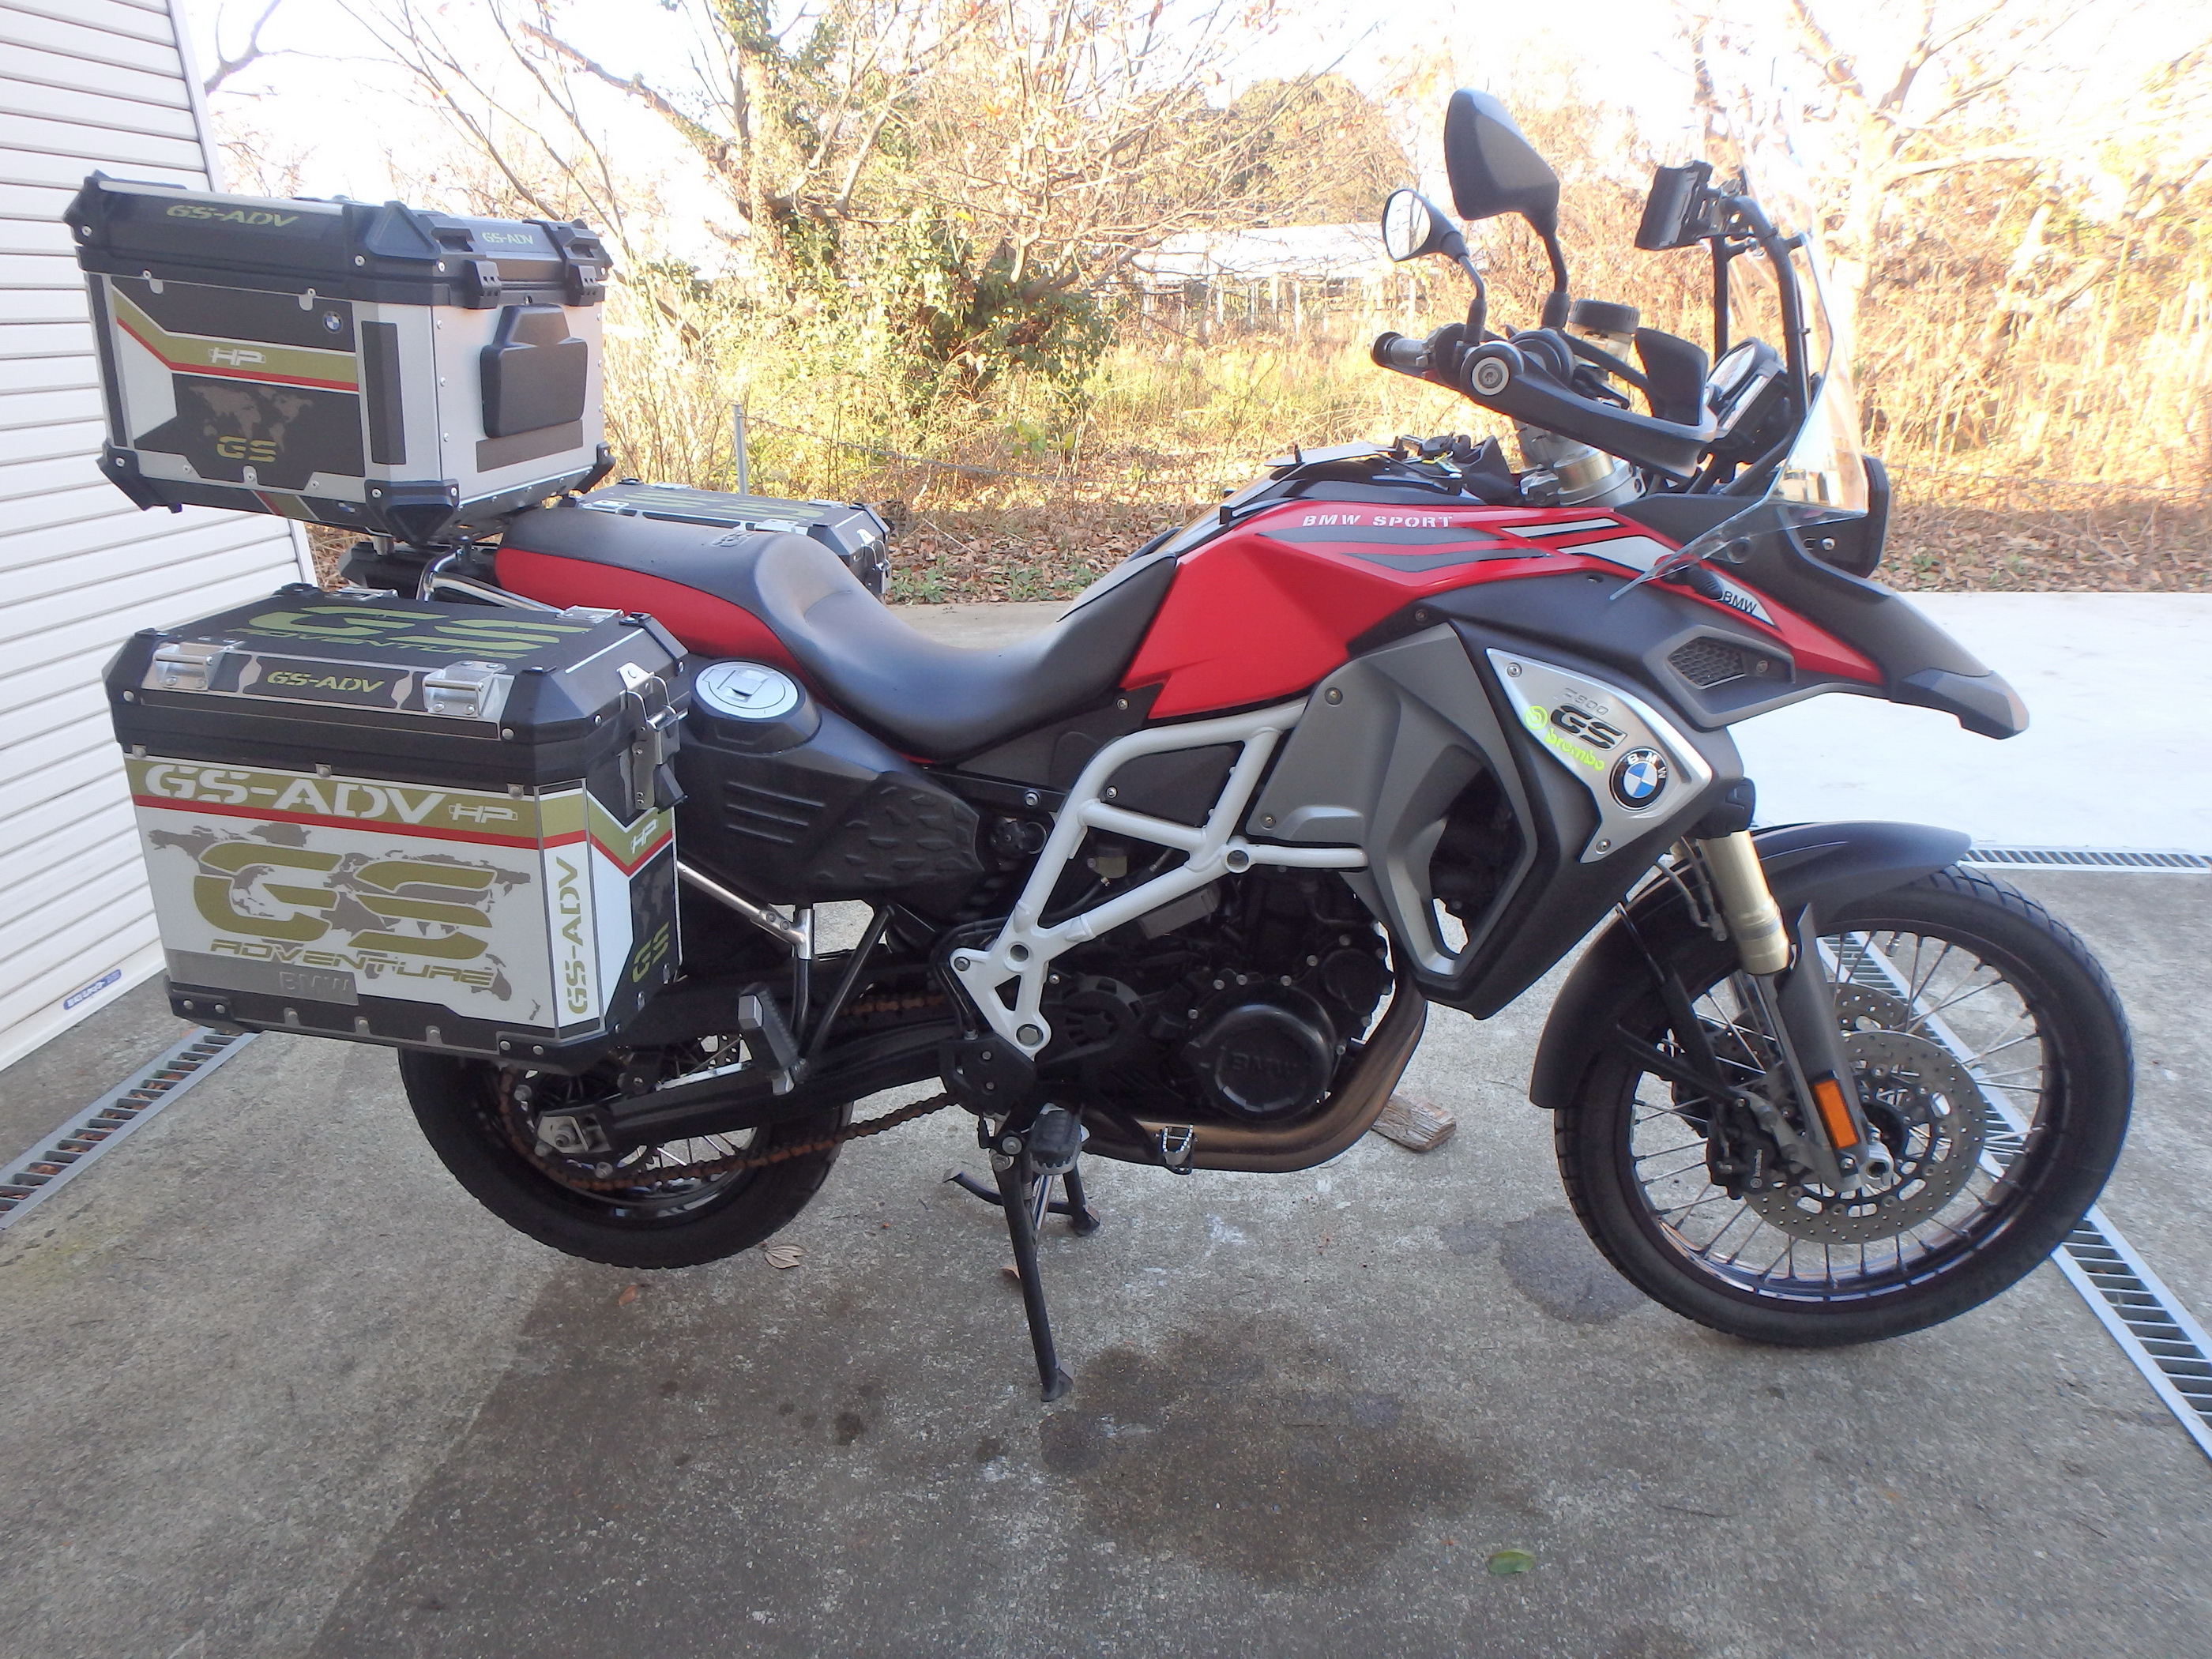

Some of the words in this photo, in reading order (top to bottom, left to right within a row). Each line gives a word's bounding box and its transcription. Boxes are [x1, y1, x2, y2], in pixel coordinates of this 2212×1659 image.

[166, 204, 299, 228] GS-ADV
[481, 231, 534, 245] GS-ADV
[208, 347, 267, 367] HP
[216, 434, 276, 462] GS
[1302, 514, 1361, 527] BMW
[1372, 514, 1454, 529] SPORT
[1721, 589, 1758, 614] BMW
[248, 605, 592, 651] GS
[266, 670, 384, 694] GS-ADV
[1550, 703, 1627, 750] GS
[1544, 727, 1605, 772] brembo
[1626, 750, 1668, 780] BMW
[144, 763, 449, 824] GS-ADV
[448, 802, 518, 825] HP
[193, 840, 498, 961] GS
[555, 856, 589, 1014] GS-ADV
[632, 920, 670, 984] GS
[209, 938, 498, 989] ADVENTURE
